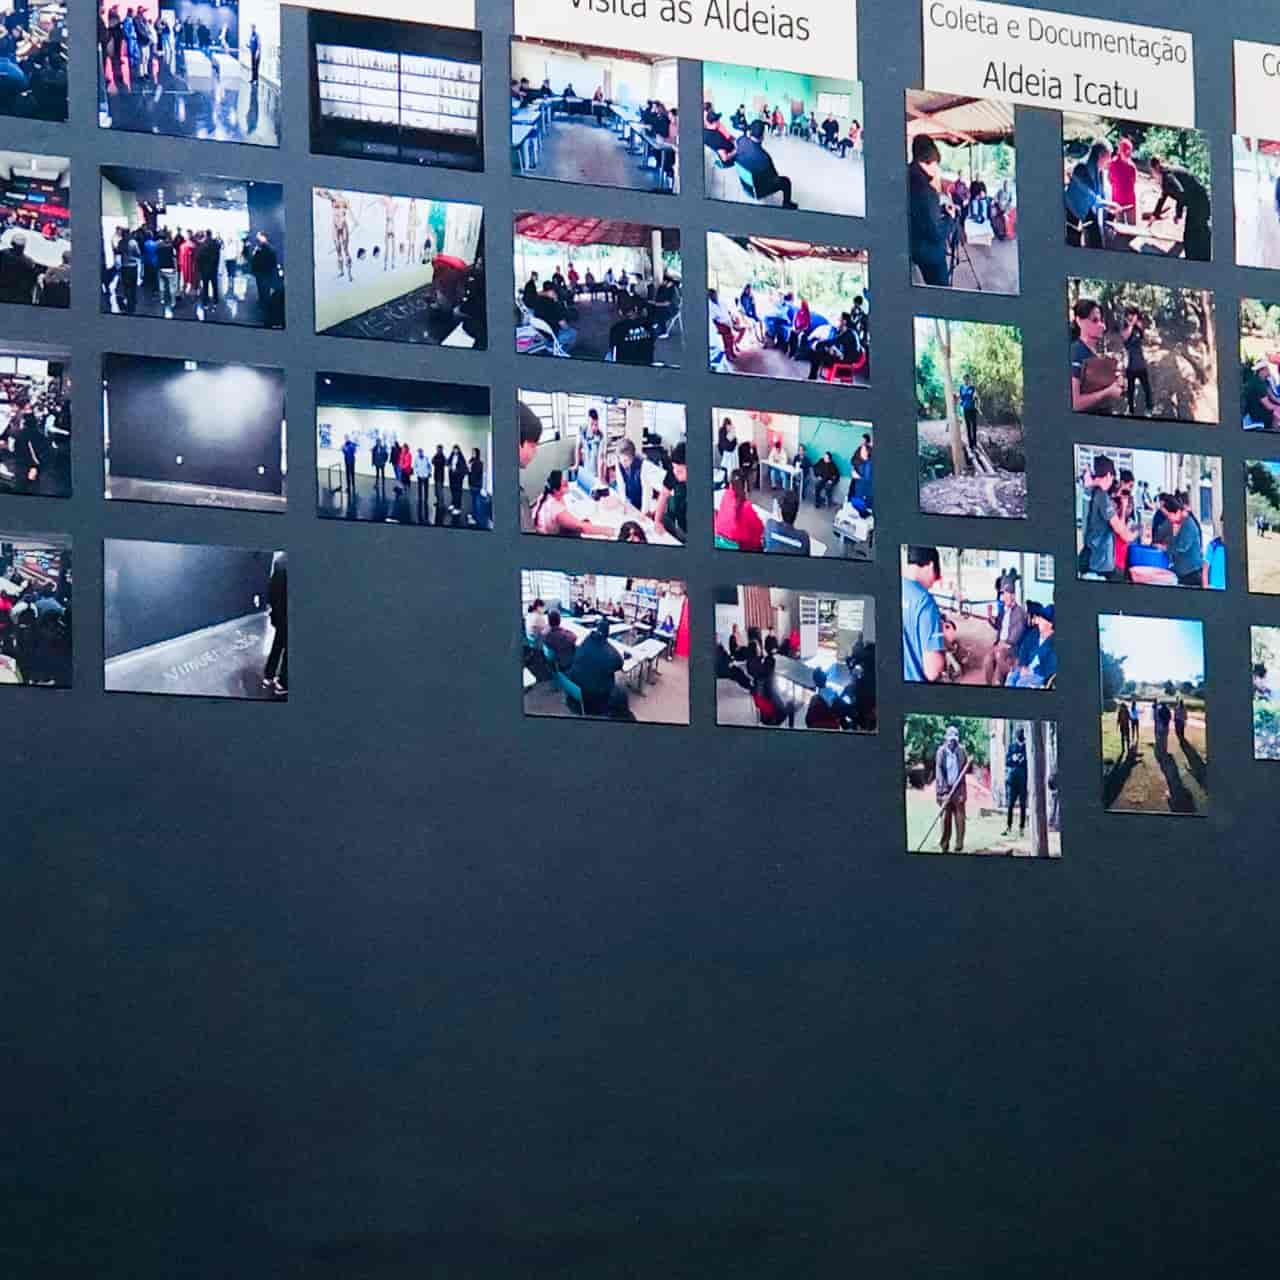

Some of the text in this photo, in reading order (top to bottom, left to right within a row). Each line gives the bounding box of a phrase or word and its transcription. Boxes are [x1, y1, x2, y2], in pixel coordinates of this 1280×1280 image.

[928, 0, 1188, 67] Coleta e Documentação
[981, 59, 1139, 112] Aldeia Icatu
